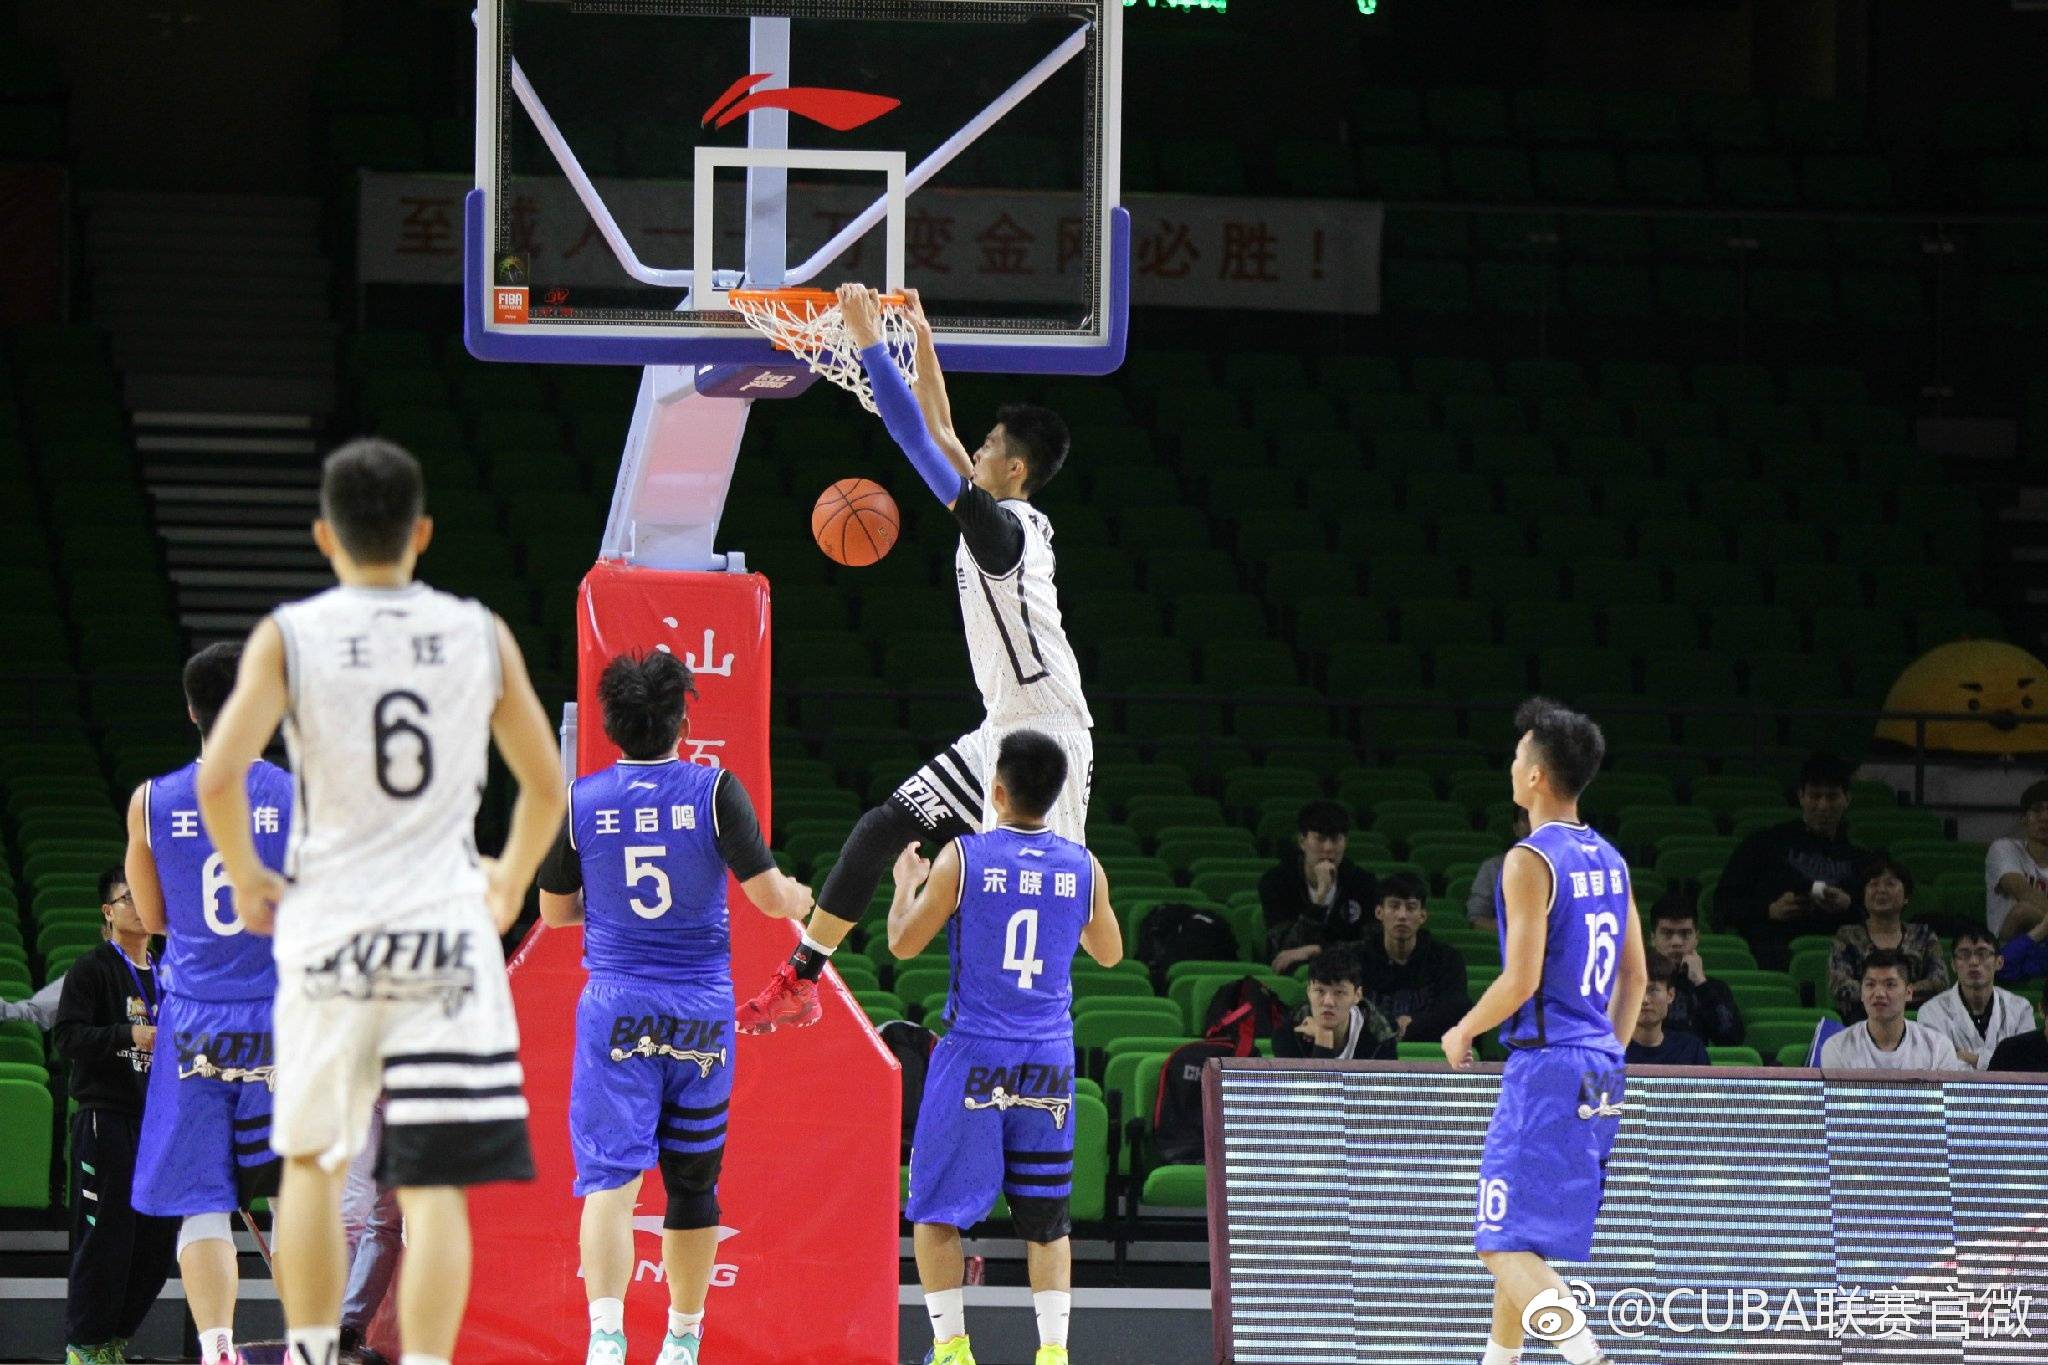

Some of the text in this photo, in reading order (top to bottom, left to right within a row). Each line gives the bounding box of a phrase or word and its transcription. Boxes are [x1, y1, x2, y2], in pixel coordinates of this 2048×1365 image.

[498, 293, 523, 306] FIBA
[373, 688, 434, 801] 6
[595, 805, 696, 834] 王启鸣
[202, 850, 247, 936] 6
[624, 845, 673, 920] 5
[983, 867, 1077, 898] 宋晓明
[1002, 908, 1044, 990] 4
[1580, 911, 1619, 996] 16
[1477, 1178, 1509, 1222] 16
